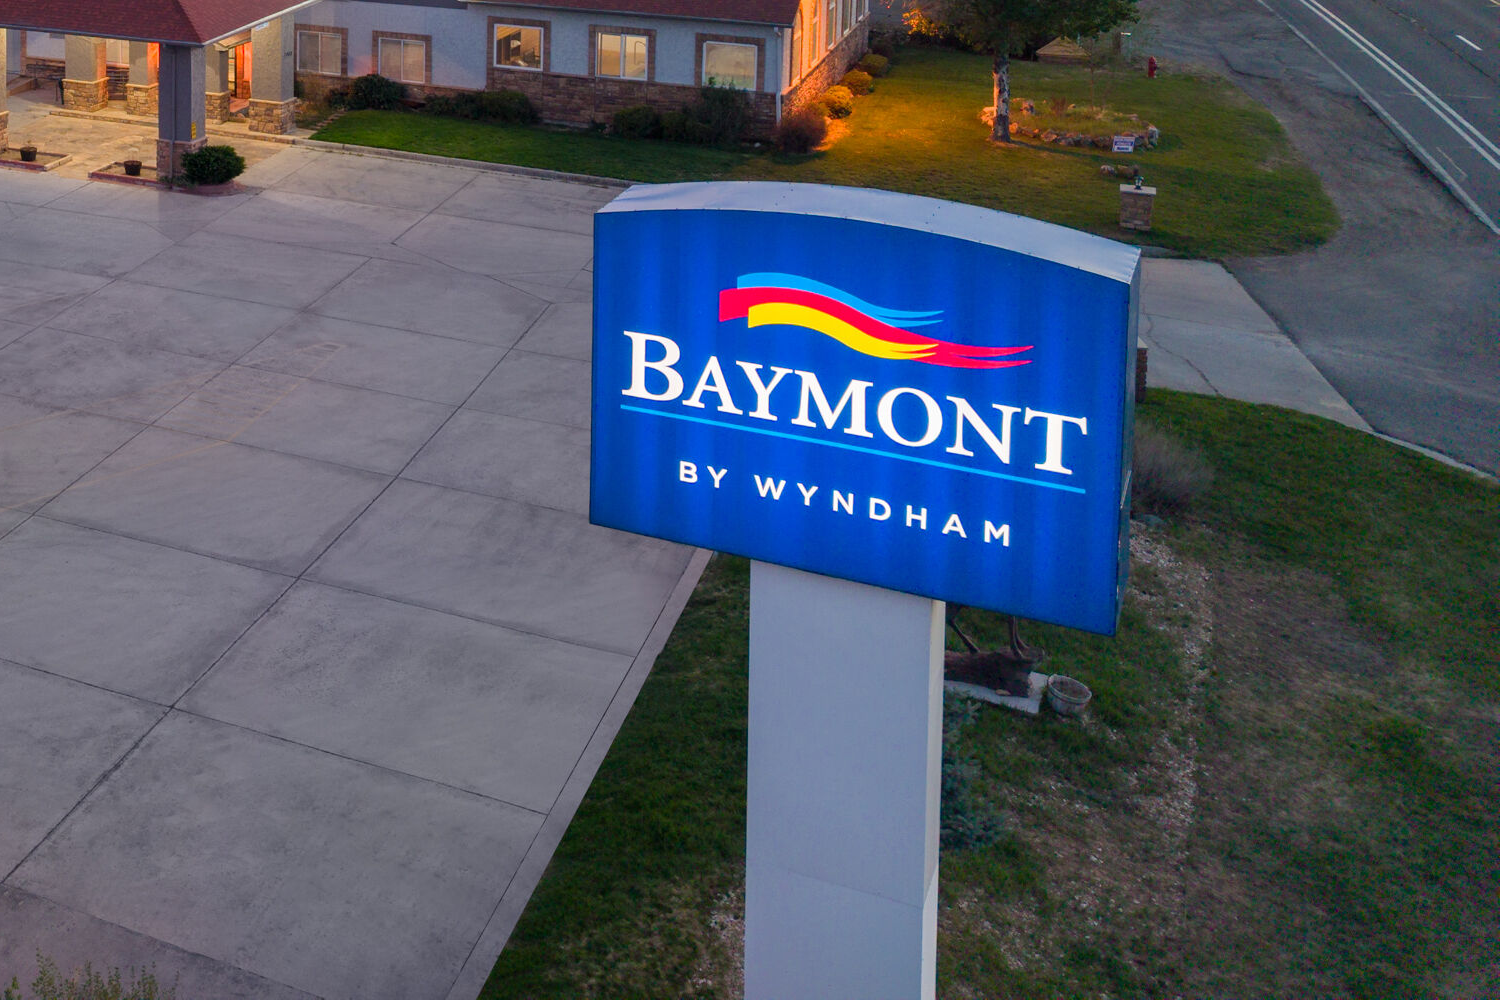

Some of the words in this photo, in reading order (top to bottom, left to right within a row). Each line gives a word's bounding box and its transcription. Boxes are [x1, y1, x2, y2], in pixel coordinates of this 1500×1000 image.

[621, 330, 1088, 475] BAYMONT
[679, 460, 728, 489] BY
[754, 474, 1011, 547] WYNDHAM
